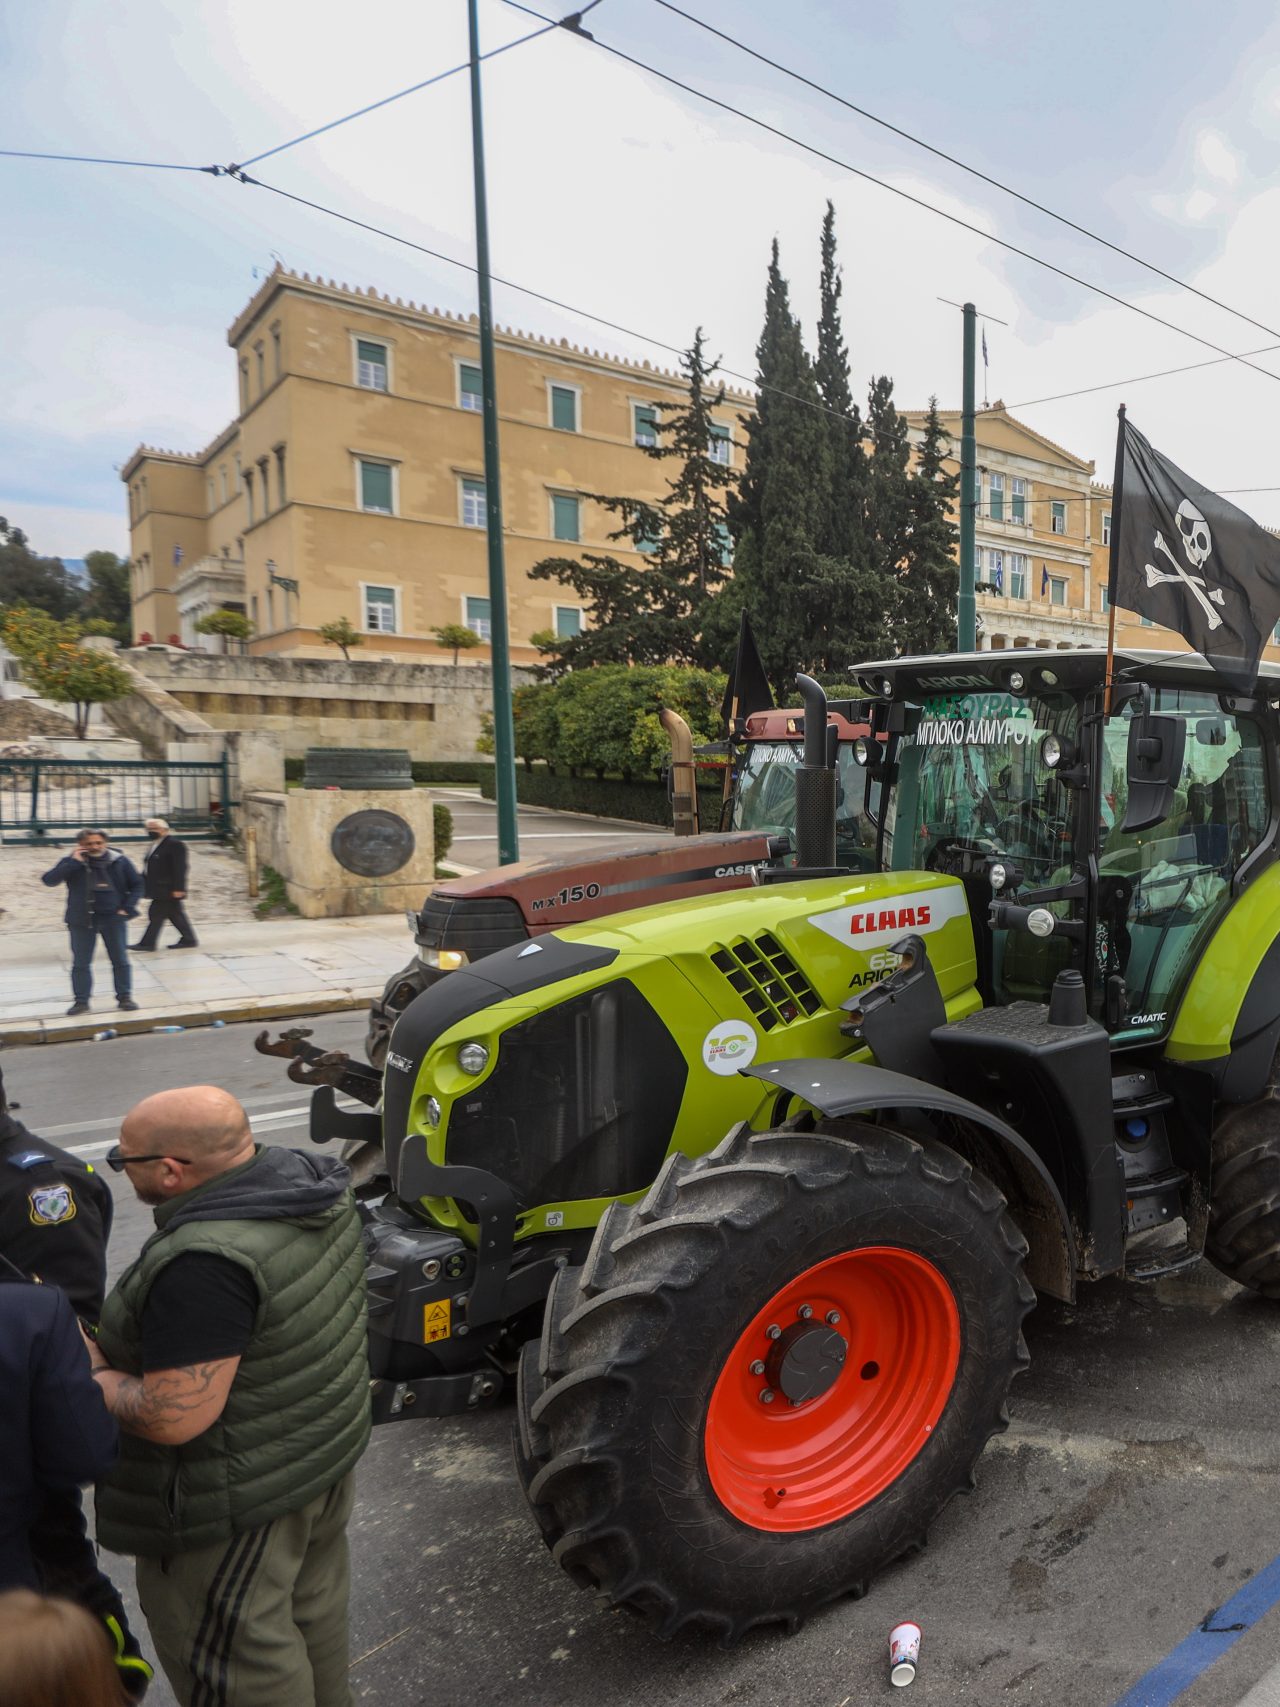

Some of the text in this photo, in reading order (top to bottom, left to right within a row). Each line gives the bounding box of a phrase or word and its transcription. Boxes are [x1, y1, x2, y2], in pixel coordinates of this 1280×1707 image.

[916, 674, 994, 688] ARION
[924, 695, 1028, 719] ΜΑΣΟΥΡΑΣ
[916, 719, 1037, 745] ΜΠΛΟΚΟ ΑΛΜΥΡΟΥ
[714, 863, 753, 878] CASE
[850, 906, 931, 934] CLAAS
[848, 966, 898, 988] ARIO
[1131, 1012, 1167, 1025] CMATIC
